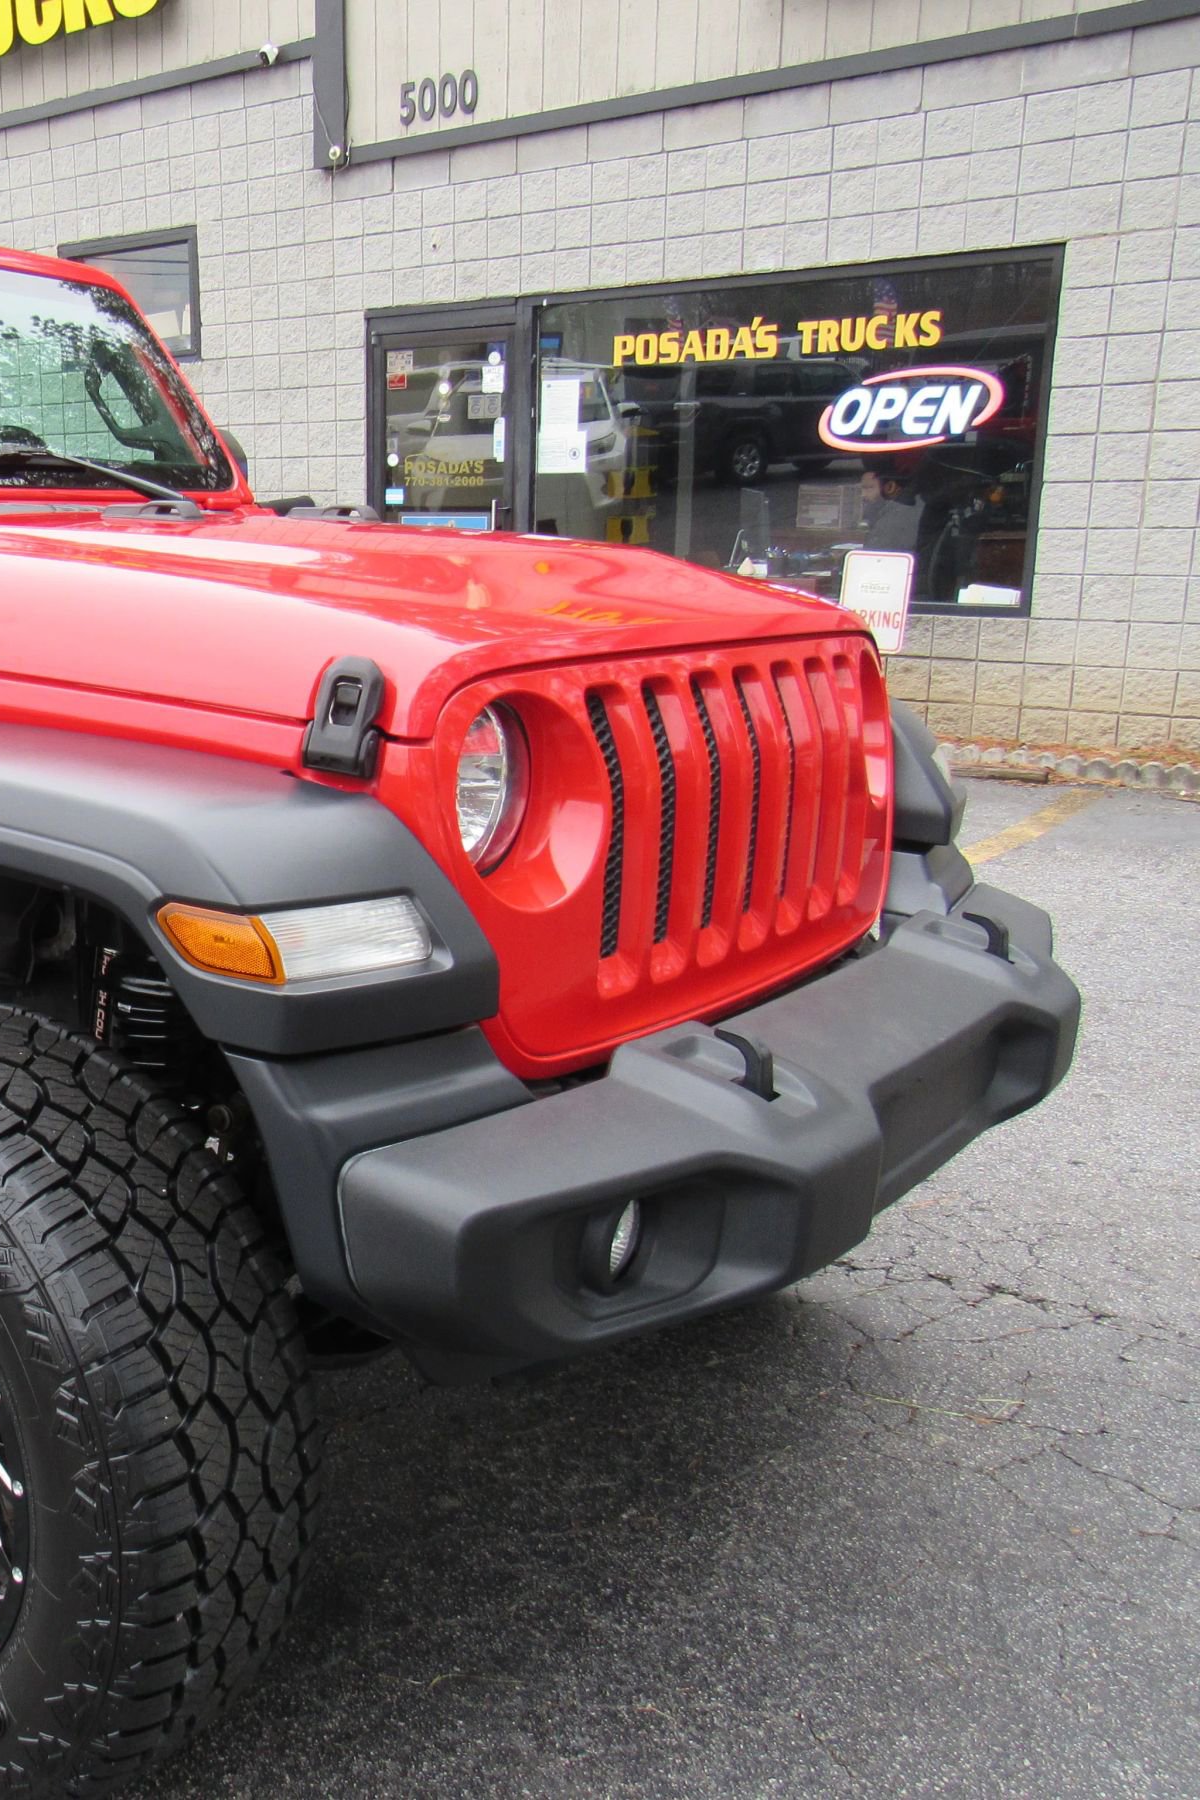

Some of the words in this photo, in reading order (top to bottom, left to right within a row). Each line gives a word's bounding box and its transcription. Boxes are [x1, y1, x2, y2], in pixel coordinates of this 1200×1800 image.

[400, 69, 478, 126] 5000
[613, 317, 778, 366] POSADA'S
[798, 310, 943, 354] TRUCKS
[829, 385, 983, 436] OPEN
[404, 460, 484, 474] POSADA'S
[404, 476, 484, 486] 770-381-2000
